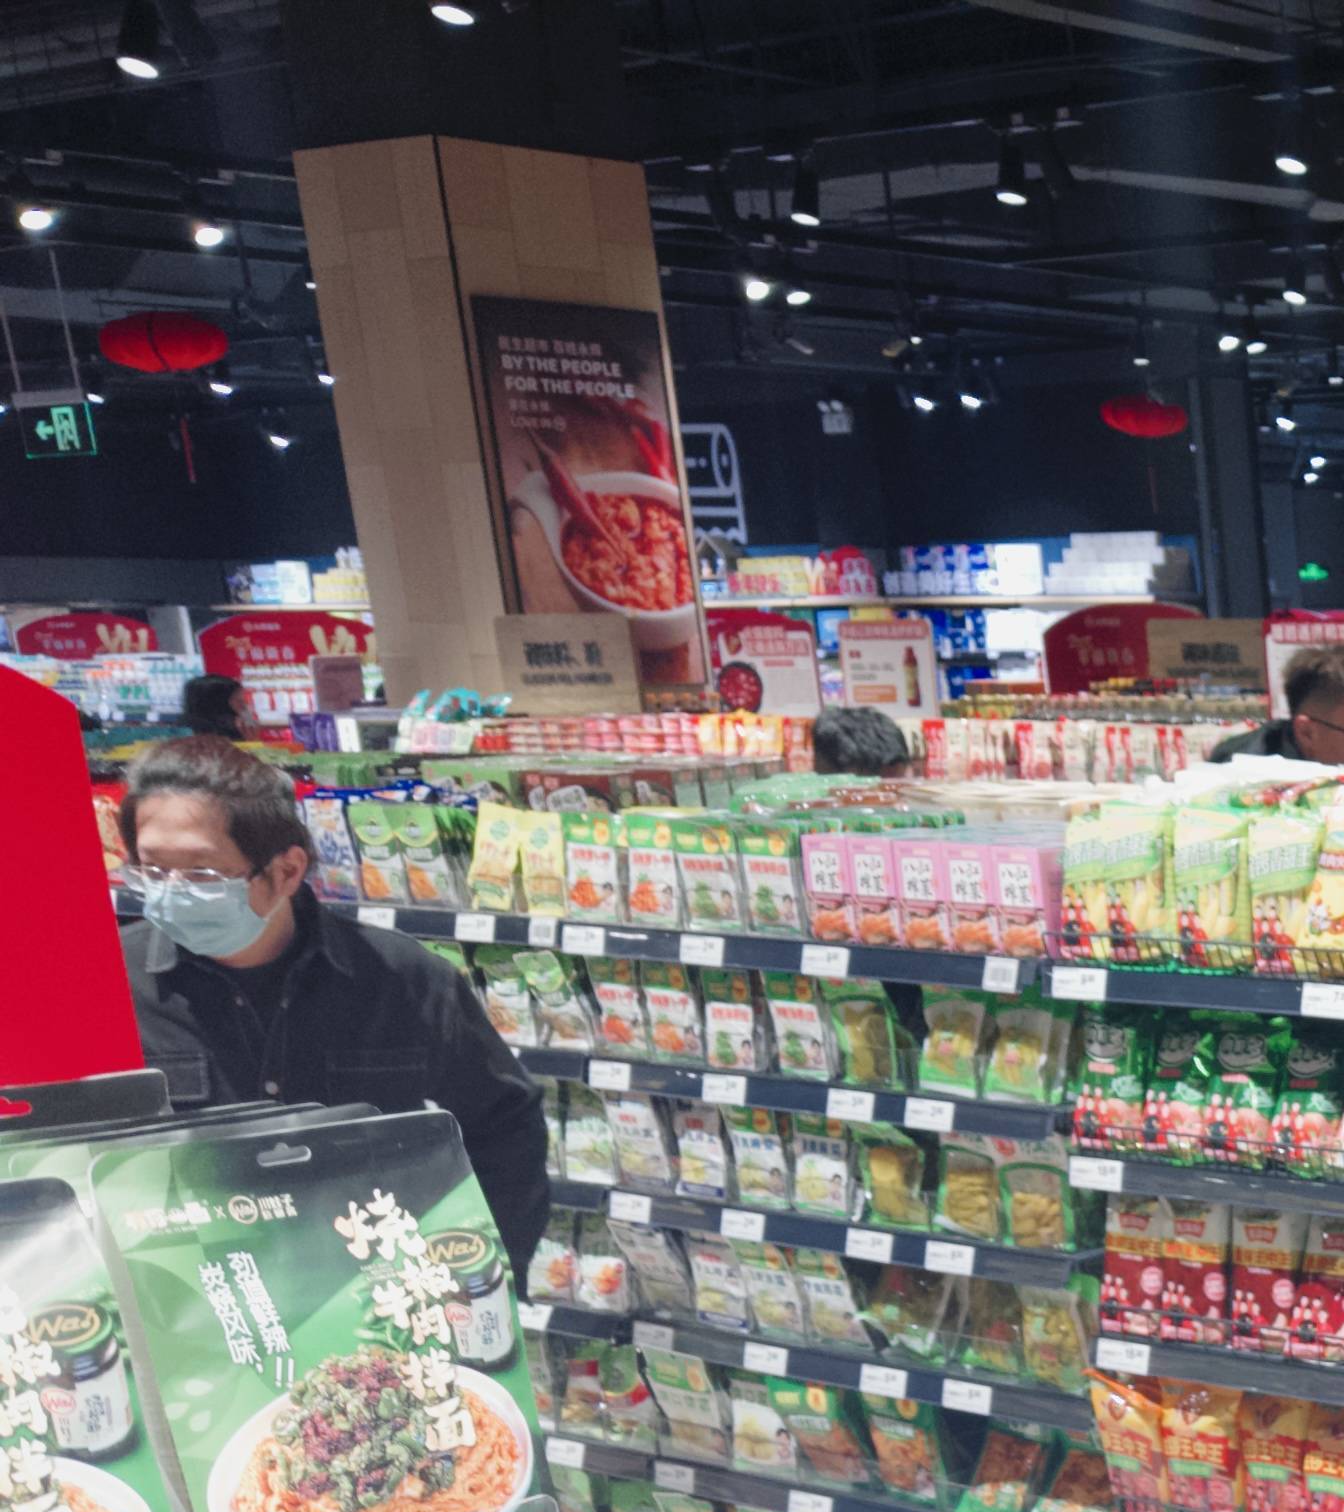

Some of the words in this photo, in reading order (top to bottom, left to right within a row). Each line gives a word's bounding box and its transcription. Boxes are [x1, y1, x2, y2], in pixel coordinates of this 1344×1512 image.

[501, 354, 523, 369] BY
[528, 356, 557, 372] THE
[560, 359, 622, 377] PEOPLE
[504, 376, 538, 392] FOR
[541, 378, 572, 394] THE
[575, 380, 635, 398] PEOPLE
